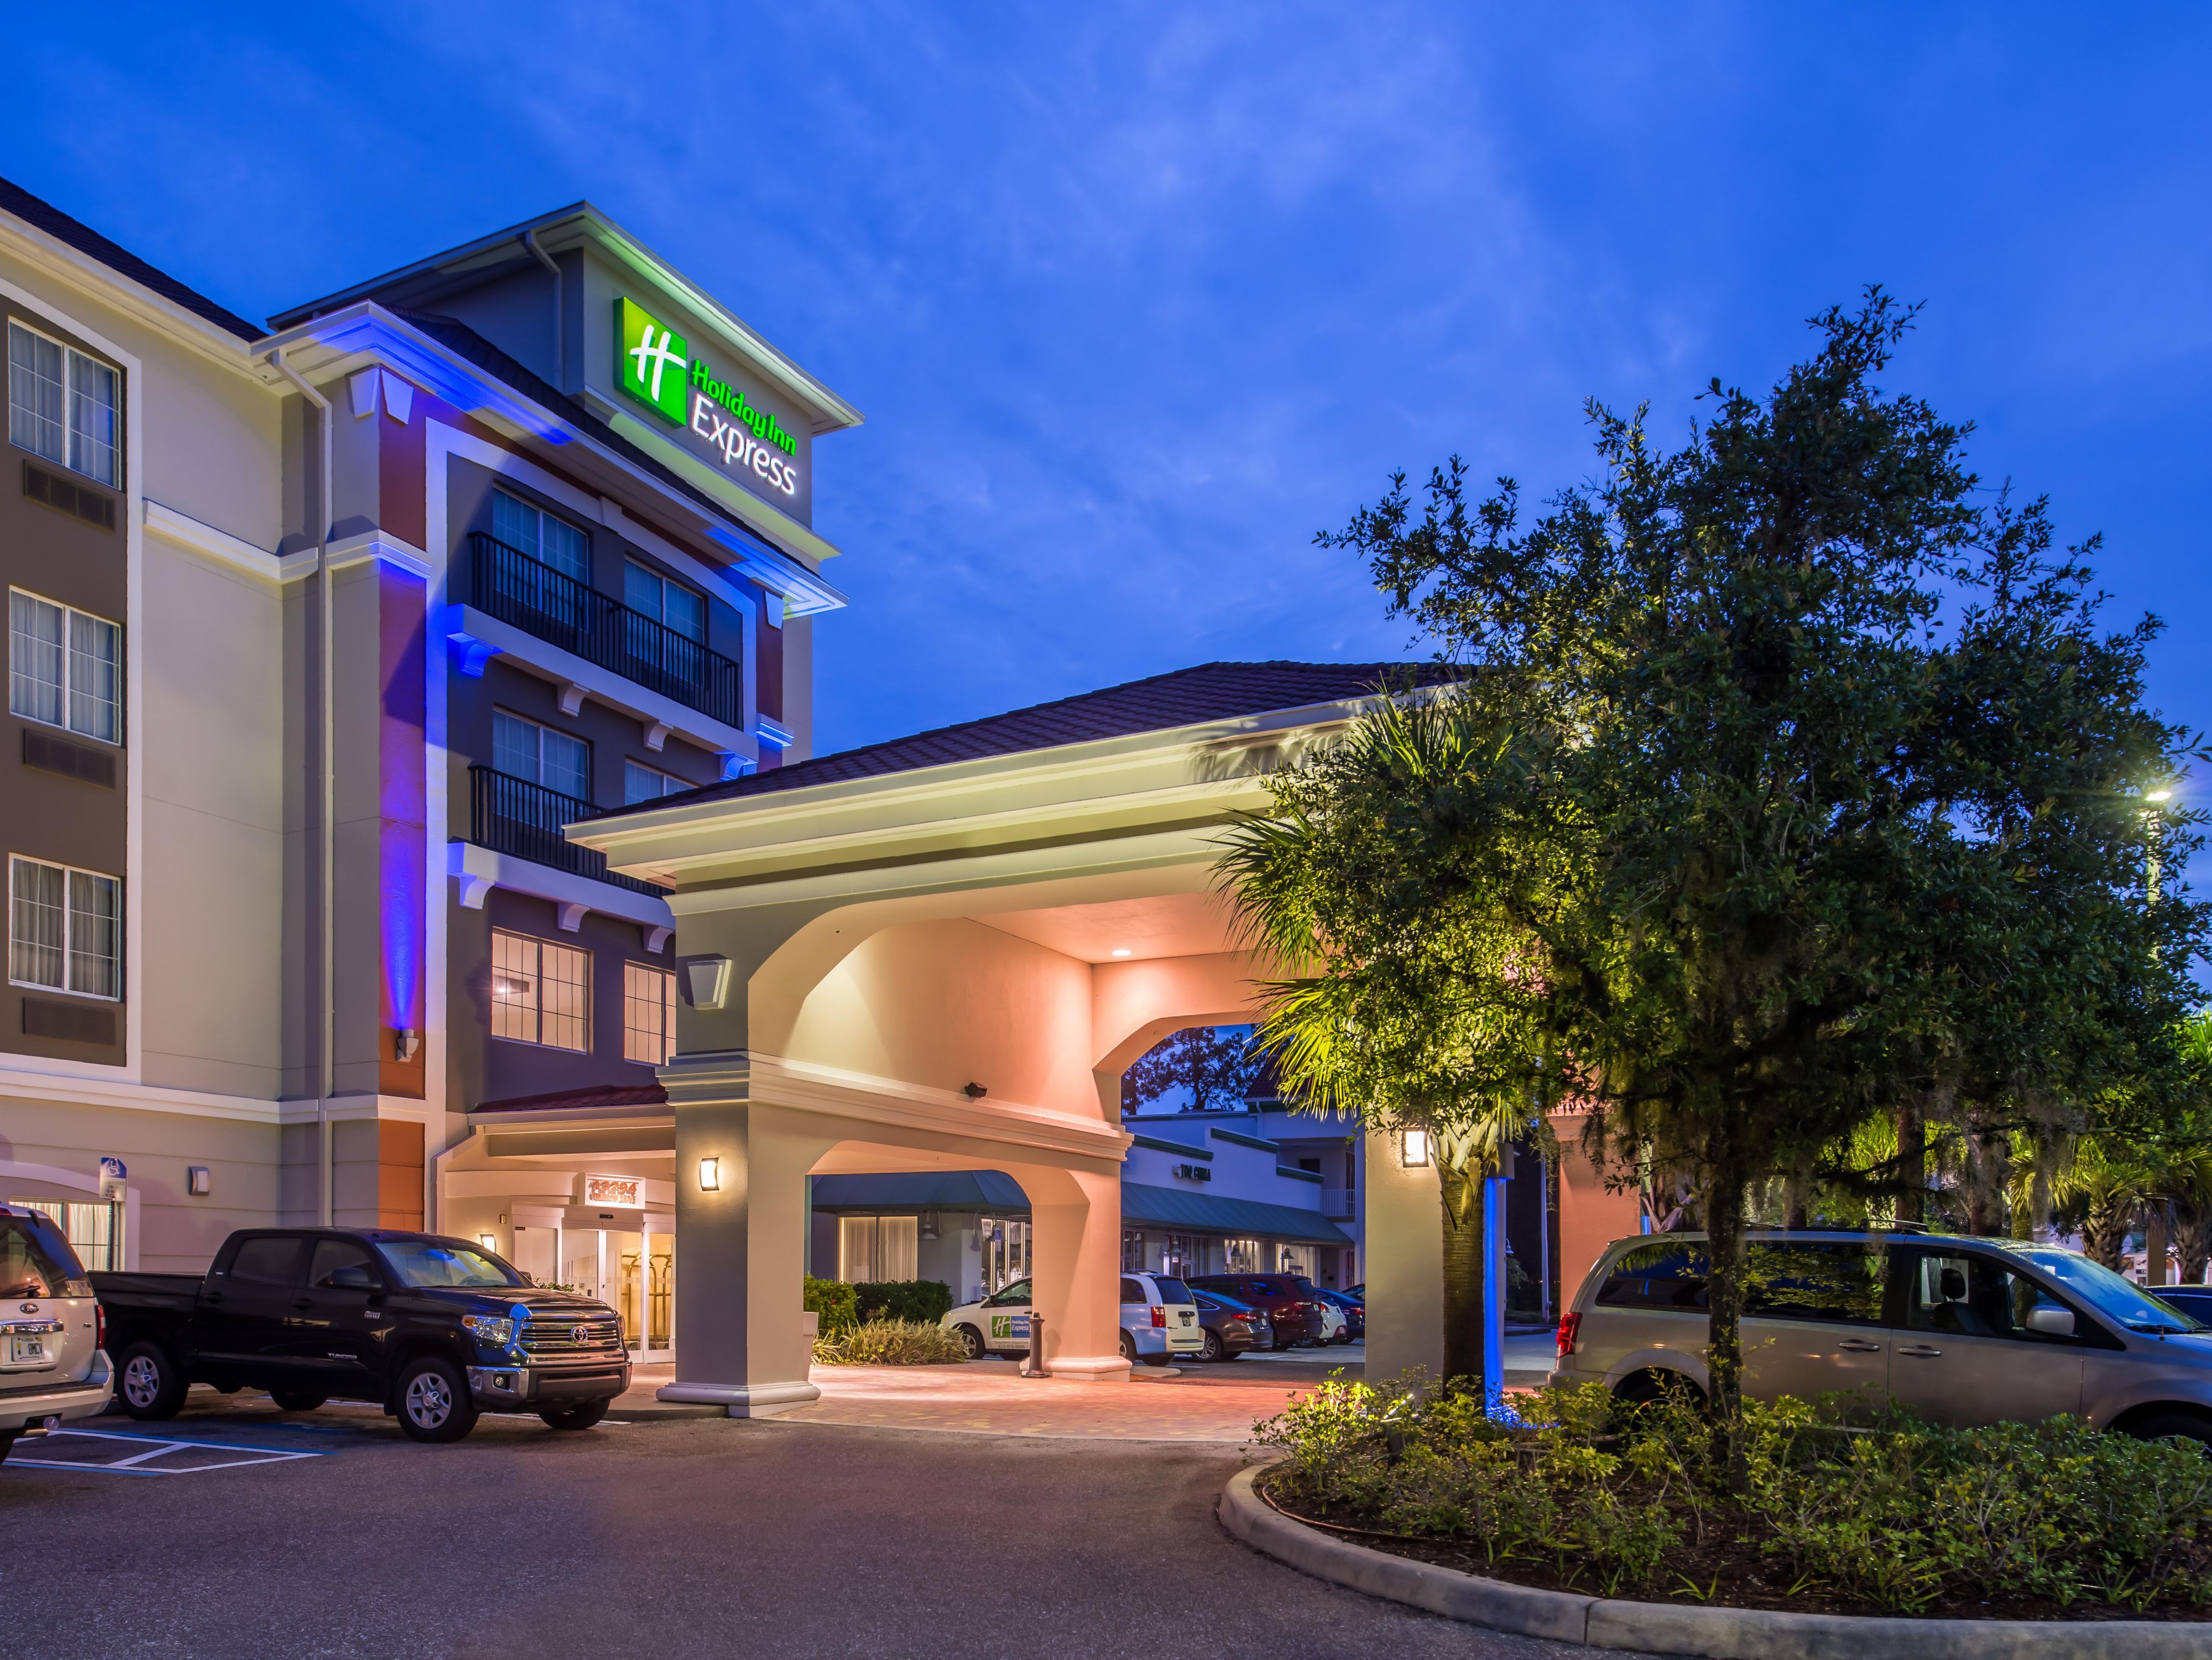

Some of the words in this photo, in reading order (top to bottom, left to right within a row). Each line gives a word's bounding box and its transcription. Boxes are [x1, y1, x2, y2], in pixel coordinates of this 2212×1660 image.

[691, 358, 767, 439] Holiday
[766, 414, 797, 456] Inn
[691, 393, 797, 496] Express
[593, 1179, 637, 1193] 13294
[1180, 1164, 1193, 1178] TOP
